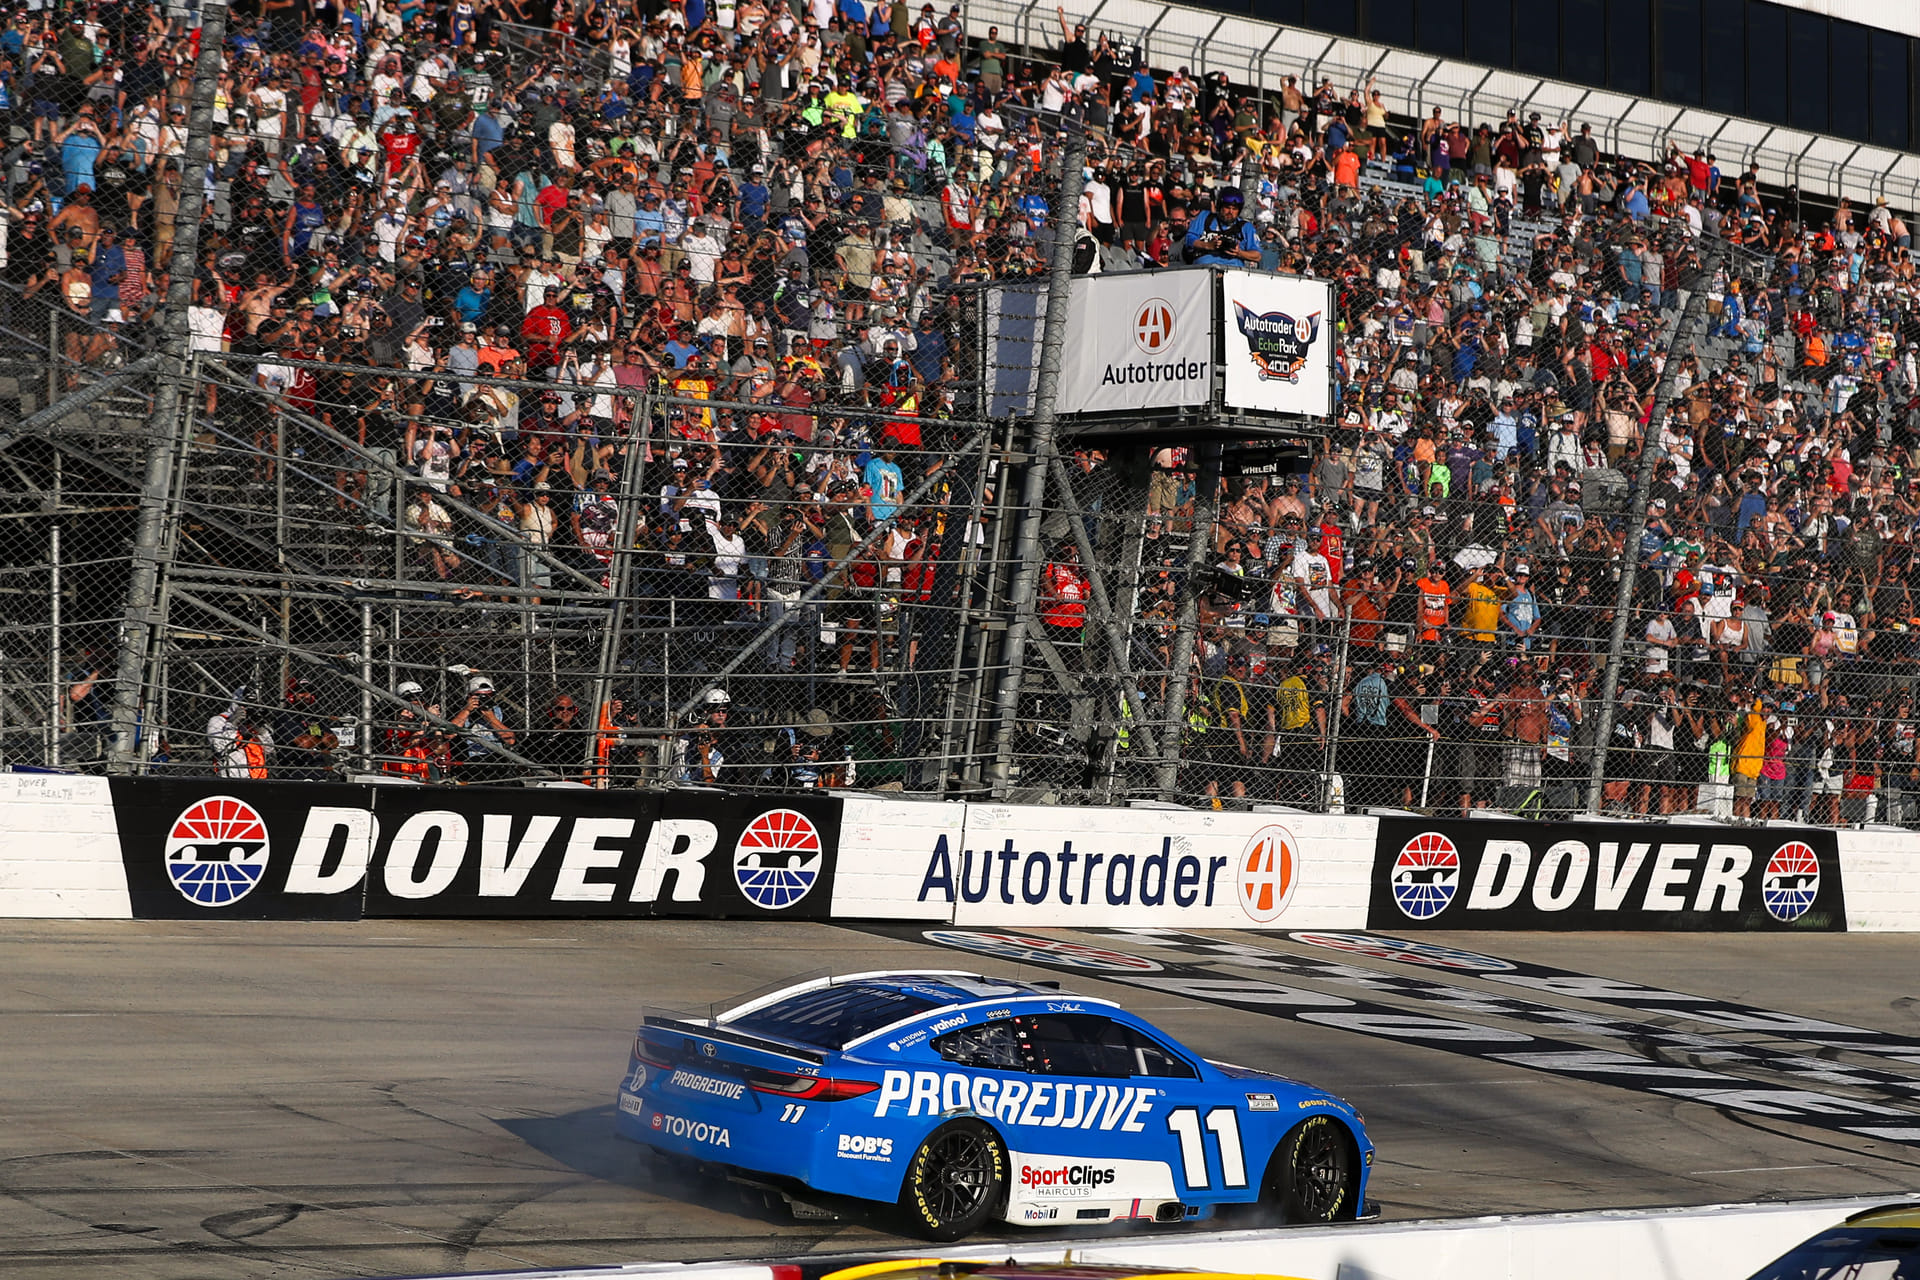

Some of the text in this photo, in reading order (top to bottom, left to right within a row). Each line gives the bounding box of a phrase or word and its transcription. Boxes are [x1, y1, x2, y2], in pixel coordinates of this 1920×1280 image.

[1244, 316, 1293, 335] Autotrader
[1258, 337, 1297, 355] EchoPark
[1102, 357, 1207, 386] Autotrader
[1268, 360, 1289, 373] 400
[1241, 463, 1277, 474] WHELEN
[283, 806, 718, 902] DOVER
[917, 833, 1227, 907] Autotrader
[1466, 839, 1753, 912] DOVER
[929, 1012, 968, 1035] yahoo!
[898, 1030, 927, 1045] NATIONAL
[671, 1070, 745, 1100] PROGRESSIVE
[874, 1070, 1157, 1132] PROGRESSIVE
[780, 1104, 806, 1124] 11
[665, 1115, 730, 1148] TOYOTA
[837, 1151, 863, 1160] Discount
[838, 1134, 893, 1155] BOB'S
[1170, 1109, 1246, 1187] 11
[988, 1140, 1004, 1182] EAGLE
[1021, 1165, 1115, 1189] SportClips
[1038, 1188, 1090, 1196] HAIRCUTS
[1025, 1209, 1049, 1219] Mobil
